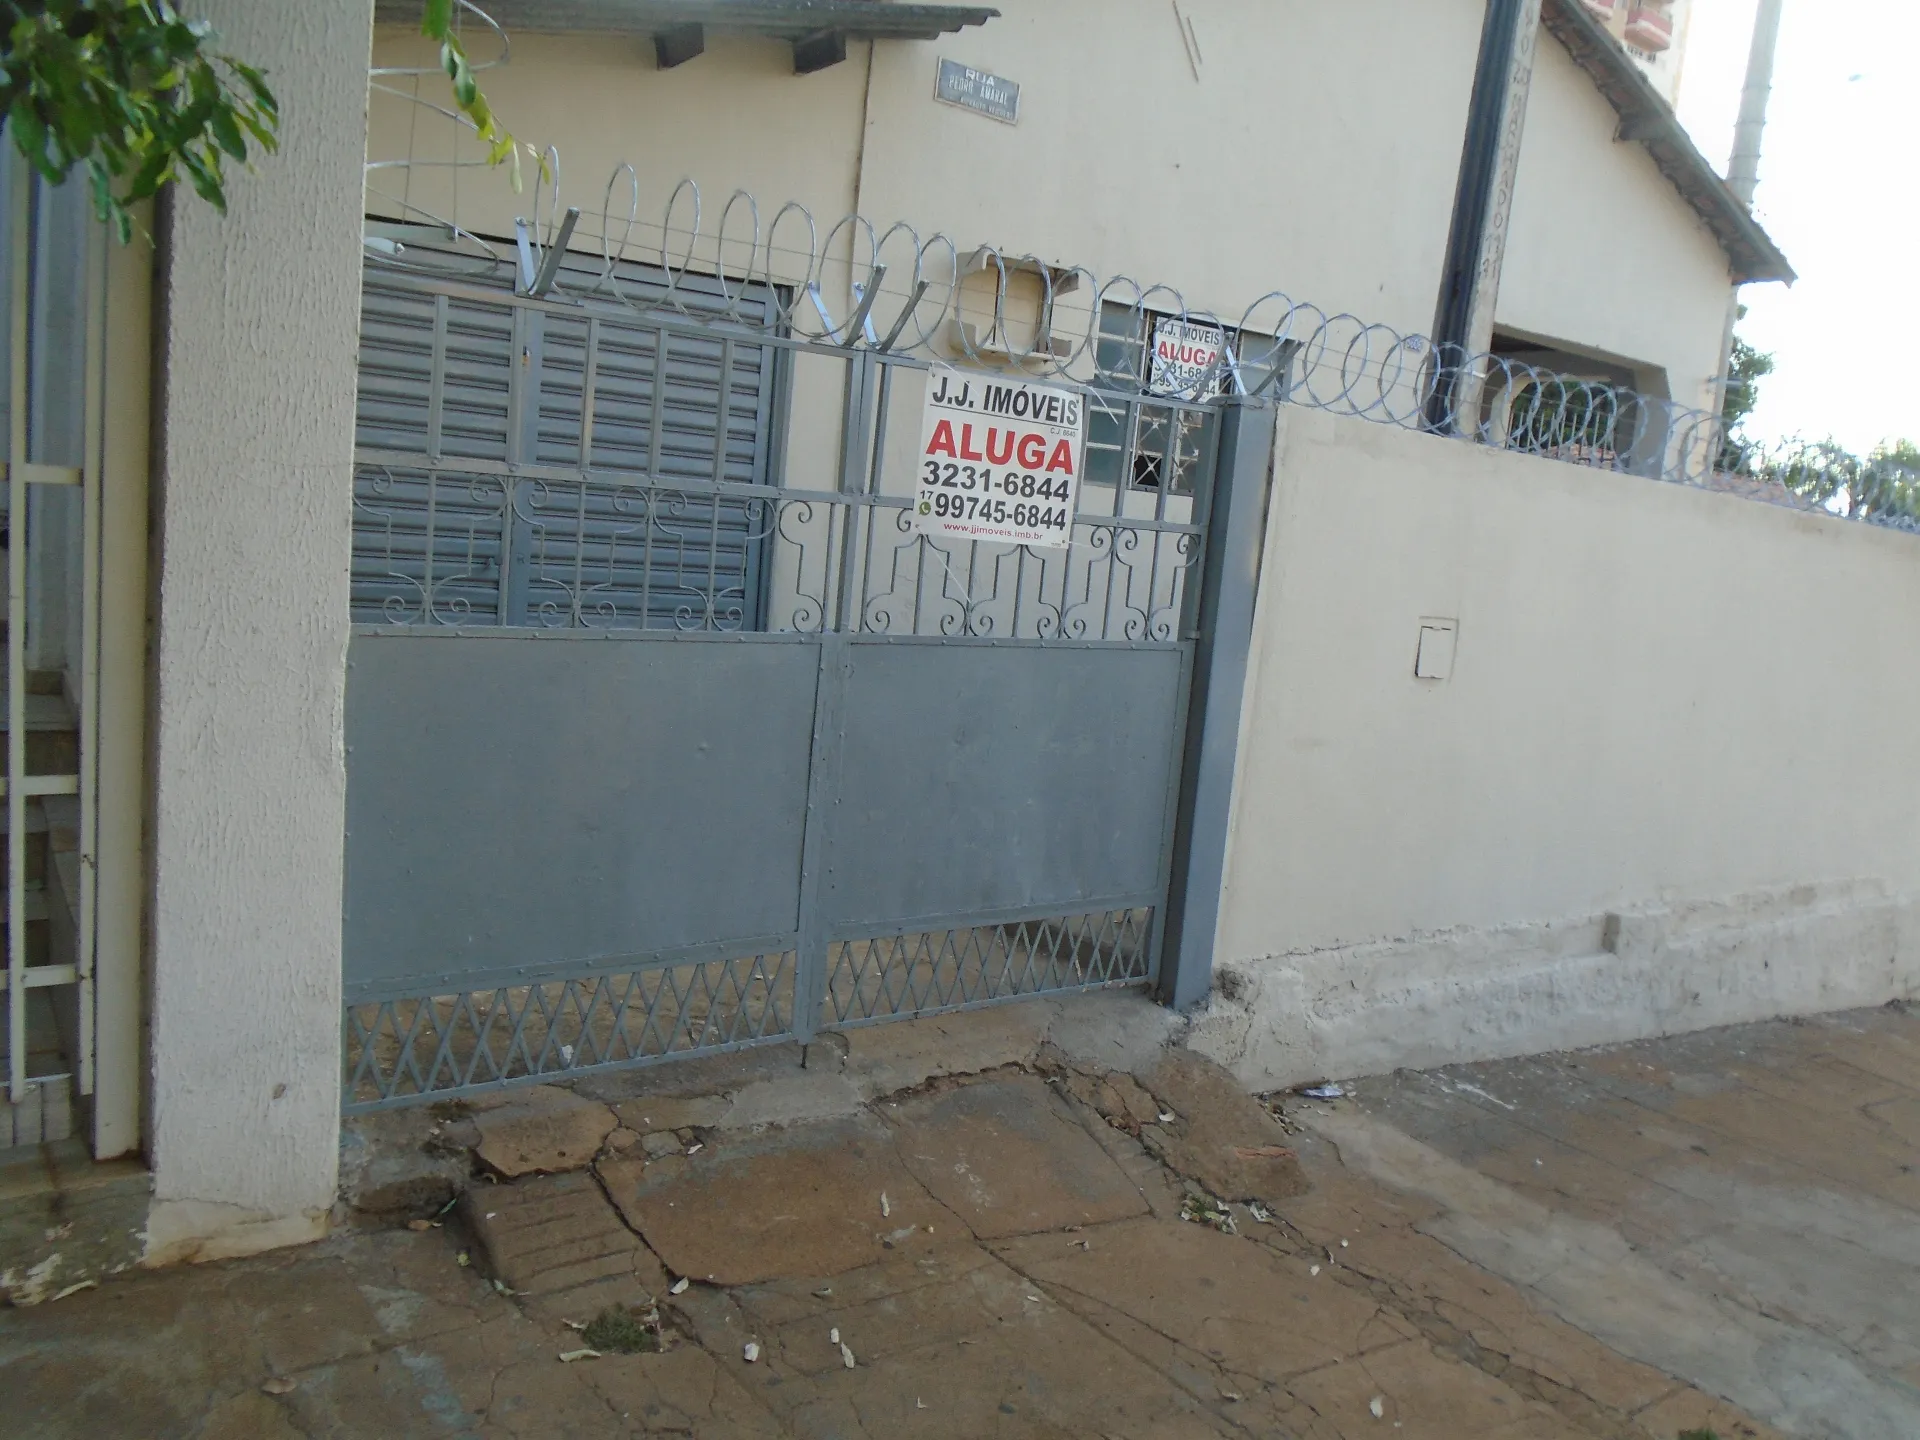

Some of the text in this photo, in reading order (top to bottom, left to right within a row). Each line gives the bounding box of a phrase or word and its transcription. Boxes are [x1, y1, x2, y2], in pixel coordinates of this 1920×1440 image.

[949, 75, 974, 94] PEDRO
[966, 68, 994, 87] RUA
[1158, 340, 1217, 366] ALUGA
[932, 376, 1079, 426] J.J. IMÓVEIS
[925, 419, 1073, 475] ALUGA
[922, 460, 1070, 502] 3231-6844
[920, 490, 934, 500] 17
[935, 492, 1066, 531] 99745-6844
[943, 522, 1044, 540] www.jjimoveis.imb.br
